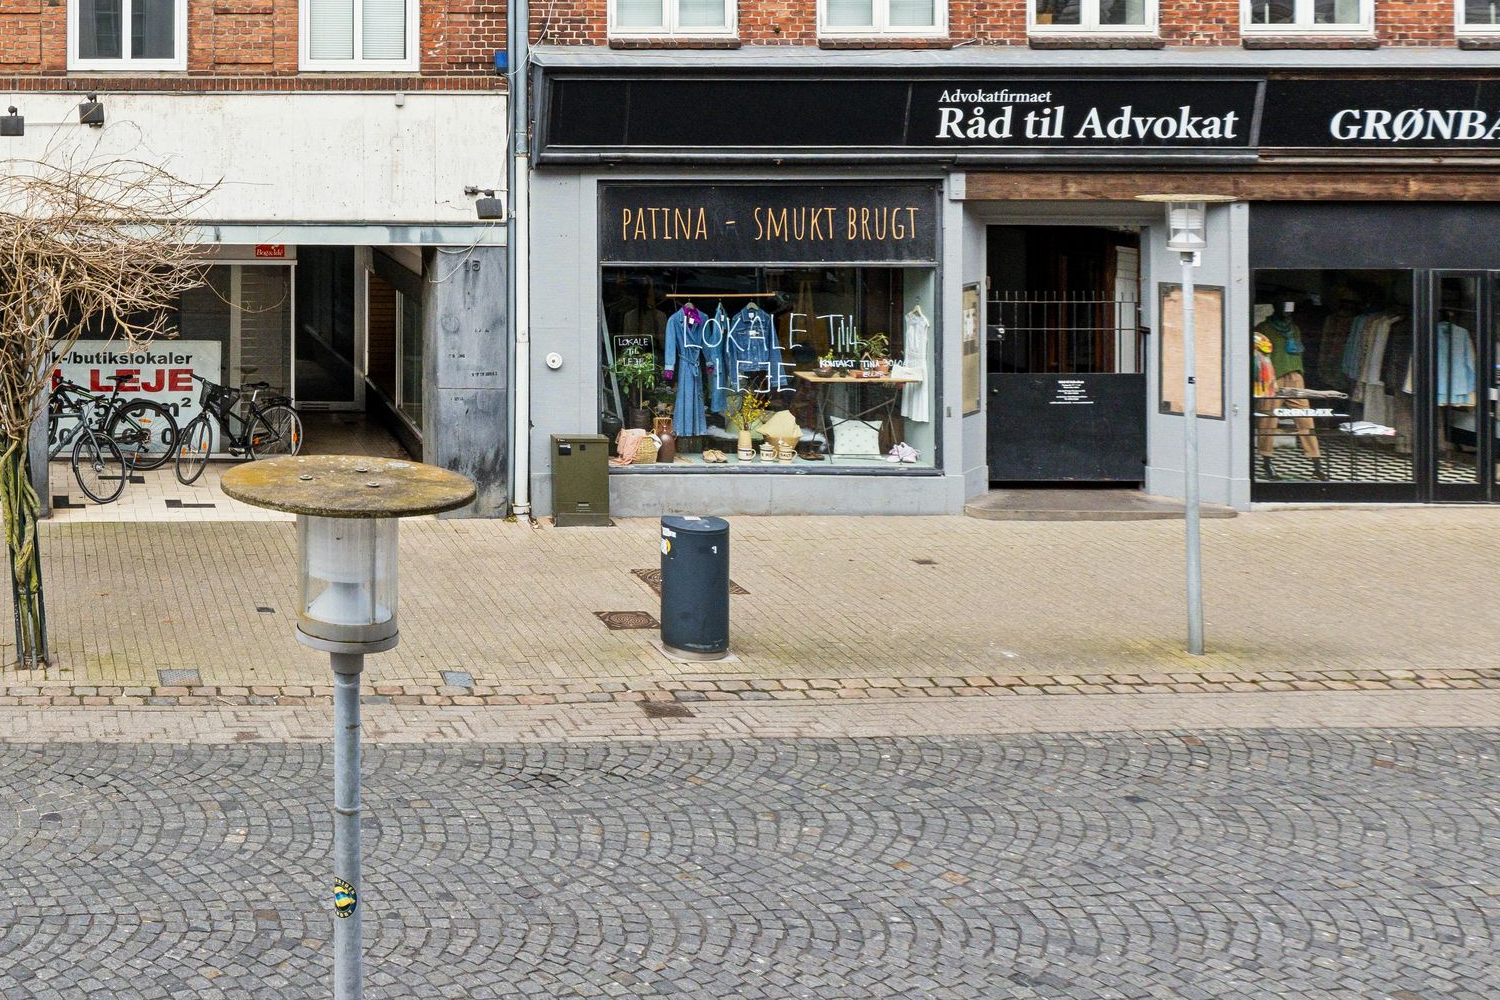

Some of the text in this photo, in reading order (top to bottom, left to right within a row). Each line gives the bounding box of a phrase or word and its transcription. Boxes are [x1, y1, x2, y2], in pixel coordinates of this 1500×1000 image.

[938, 89, 1052, 103] Advokatfirmaet
[935, 105, 1239, 139] Råd til Advokat
[622, 207, 708, 241] PATINA
[754, 207, 837, 242] SMUKT
[847, 206, 919, 241] BRUGT
[618, 338, 649, 346] LOKALE
[684, 313, 807, 353] LOKALE
[716, 358, 797, 393] LEJE
[819, 359, 856, 368] KONTAKT
[90, 369, 193, 393] LEJE
